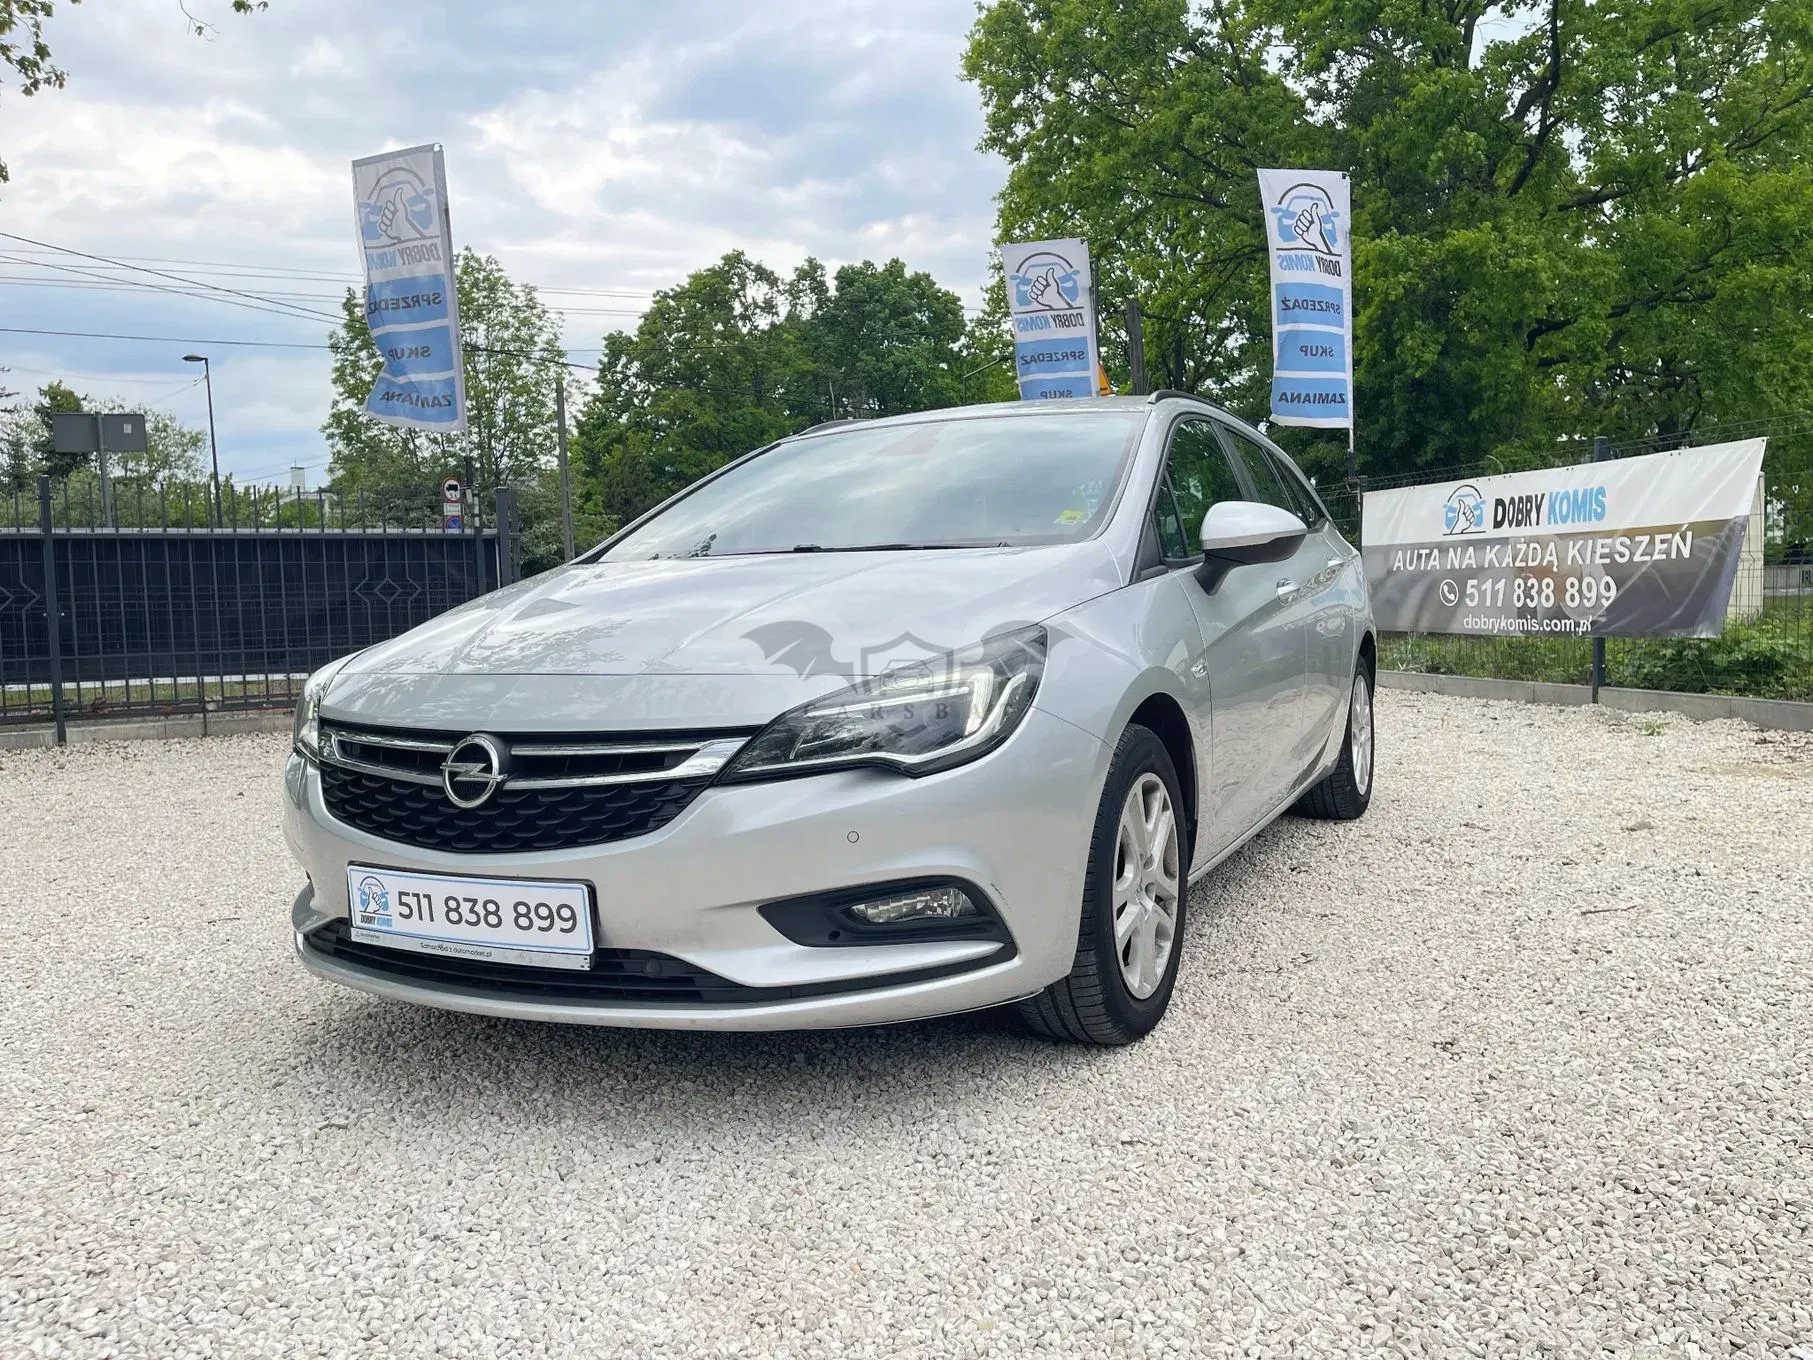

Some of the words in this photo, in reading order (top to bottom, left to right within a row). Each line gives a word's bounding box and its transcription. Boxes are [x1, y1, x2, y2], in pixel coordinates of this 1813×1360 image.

[1493, 493, 1545, 529] DOBRY
[1547, 486, 1607, 525] KOMIS
[1393, 548, 1440, 572] AUTA
[1447, 546, 1480, 570] NA
[1484, 538, 1559, 573] KAŻDĄ
[1567, 524, 1693, 566] KIESZEŃ
[1465, 578, 1507, 607] 511
[1513, 577, 1555, 608] 838
[1565, 575, 1617, 608] 899
[1463, 614, 1593, 636] dobrykomis.com.pl
[397, 890, 435, 922] 511
[444, 895, 503, 929] 838
[512, 900, 578, 934] 899
